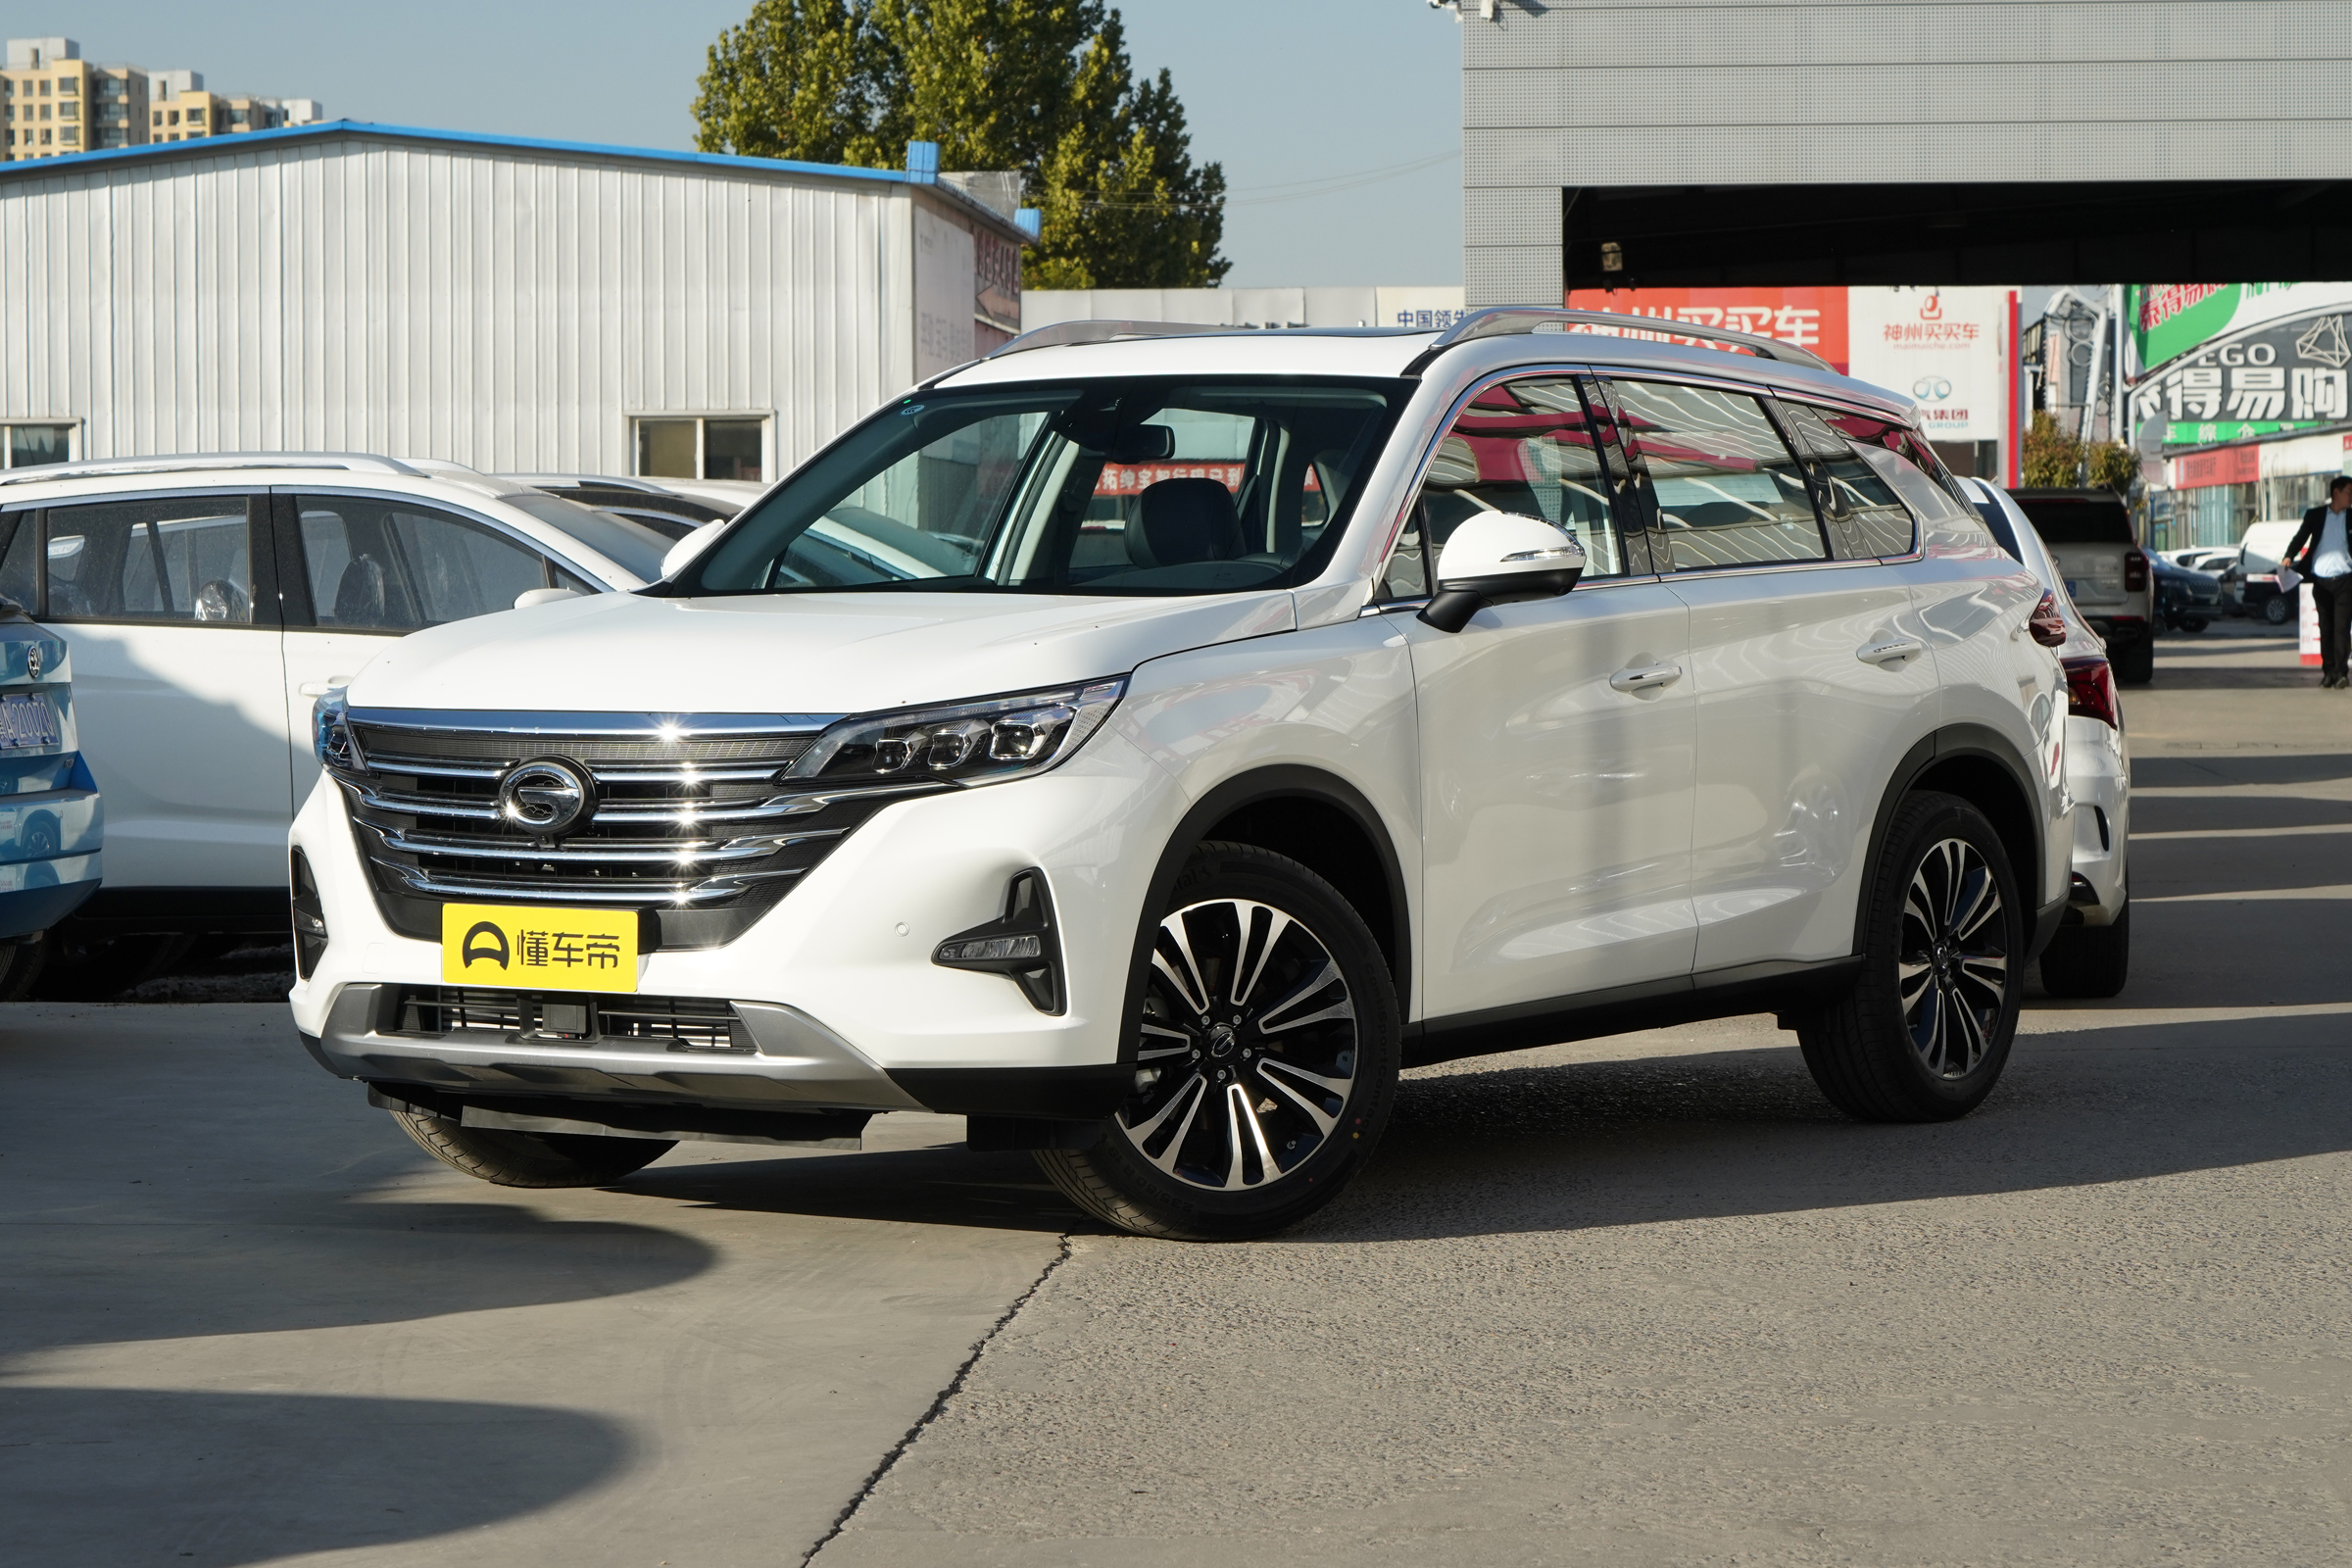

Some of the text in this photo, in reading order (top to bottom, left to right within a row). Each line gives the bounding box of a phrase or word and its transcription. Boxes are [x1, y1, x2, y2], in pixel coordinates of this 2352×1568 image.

[1884, 322, 1980, 341] 神州买买车
[516, 929, 620, 969] 懂车帝
